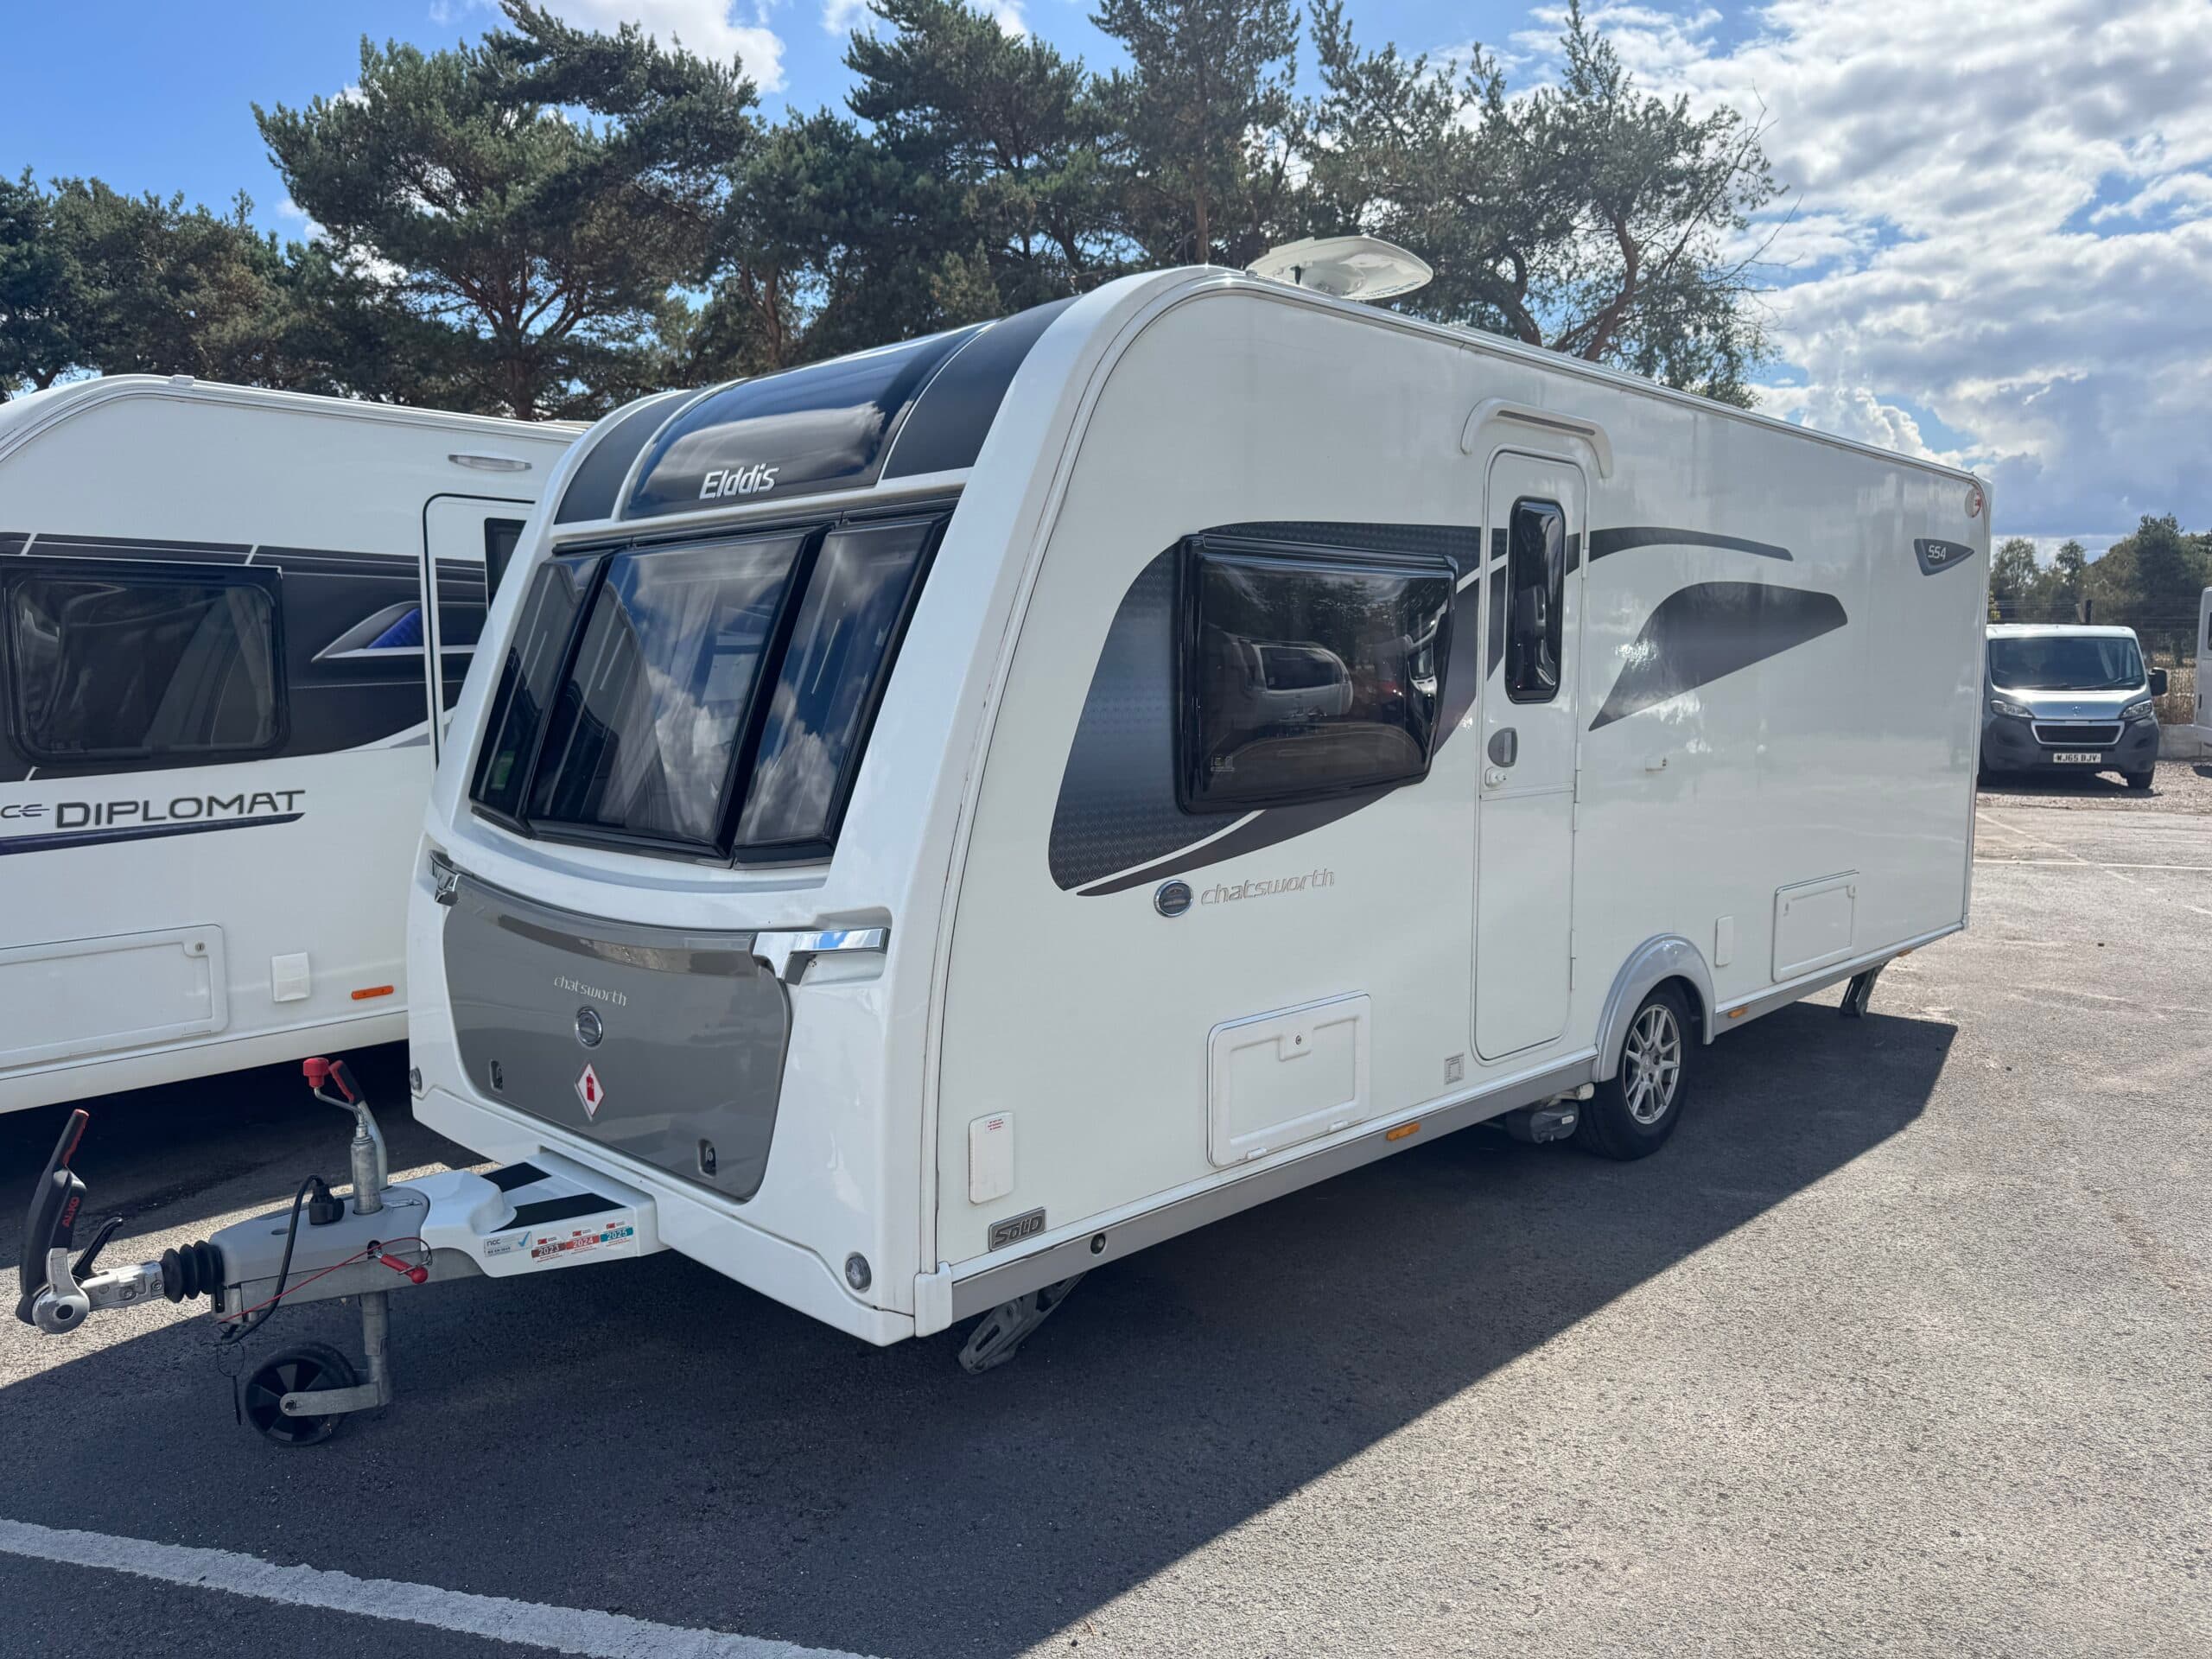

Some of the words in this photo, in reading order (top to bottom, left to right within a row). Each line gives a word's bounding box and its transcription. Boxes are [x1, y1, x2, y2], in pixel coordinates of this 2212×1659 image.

[699, 463, 780, 499] Elddis
[1928, 544, 1947, 560] 554
[56, 790, 306, 829] DIPLOMAT
[1201, 868, 1335, 906] chatsworth
[554, 976, 627, 1007] chatsworth
[573, 1238, 594, 1249] 2024
[607, 1230, 627, 1240] 2025
